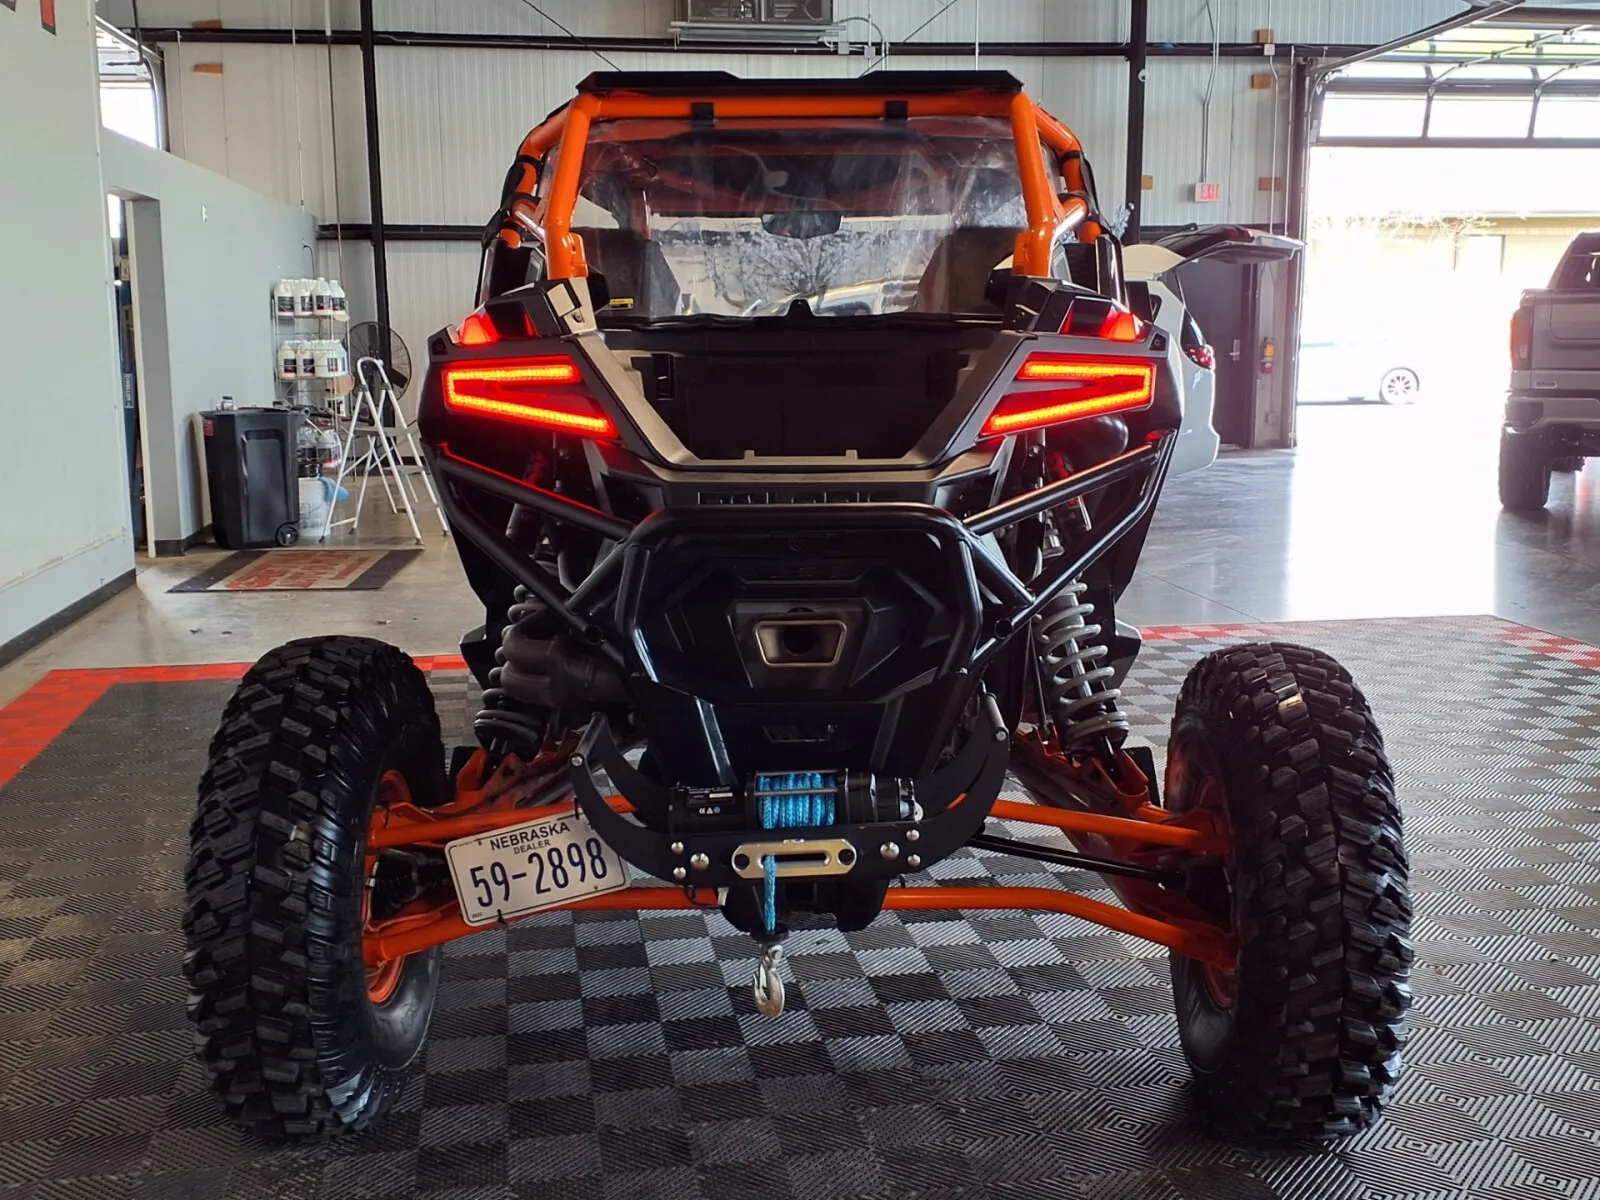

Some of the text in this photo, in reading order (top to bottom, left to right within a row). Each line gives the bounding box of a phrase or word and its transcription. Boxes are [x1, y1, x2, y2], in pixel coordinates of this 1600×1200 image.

[1200, 183, 1220, 199] EXIT
[490, 821, 570, 851] NEBRASKA
[513, 839, 550, 855] DEALER
[469, 837, 608, 908] 59-2898
